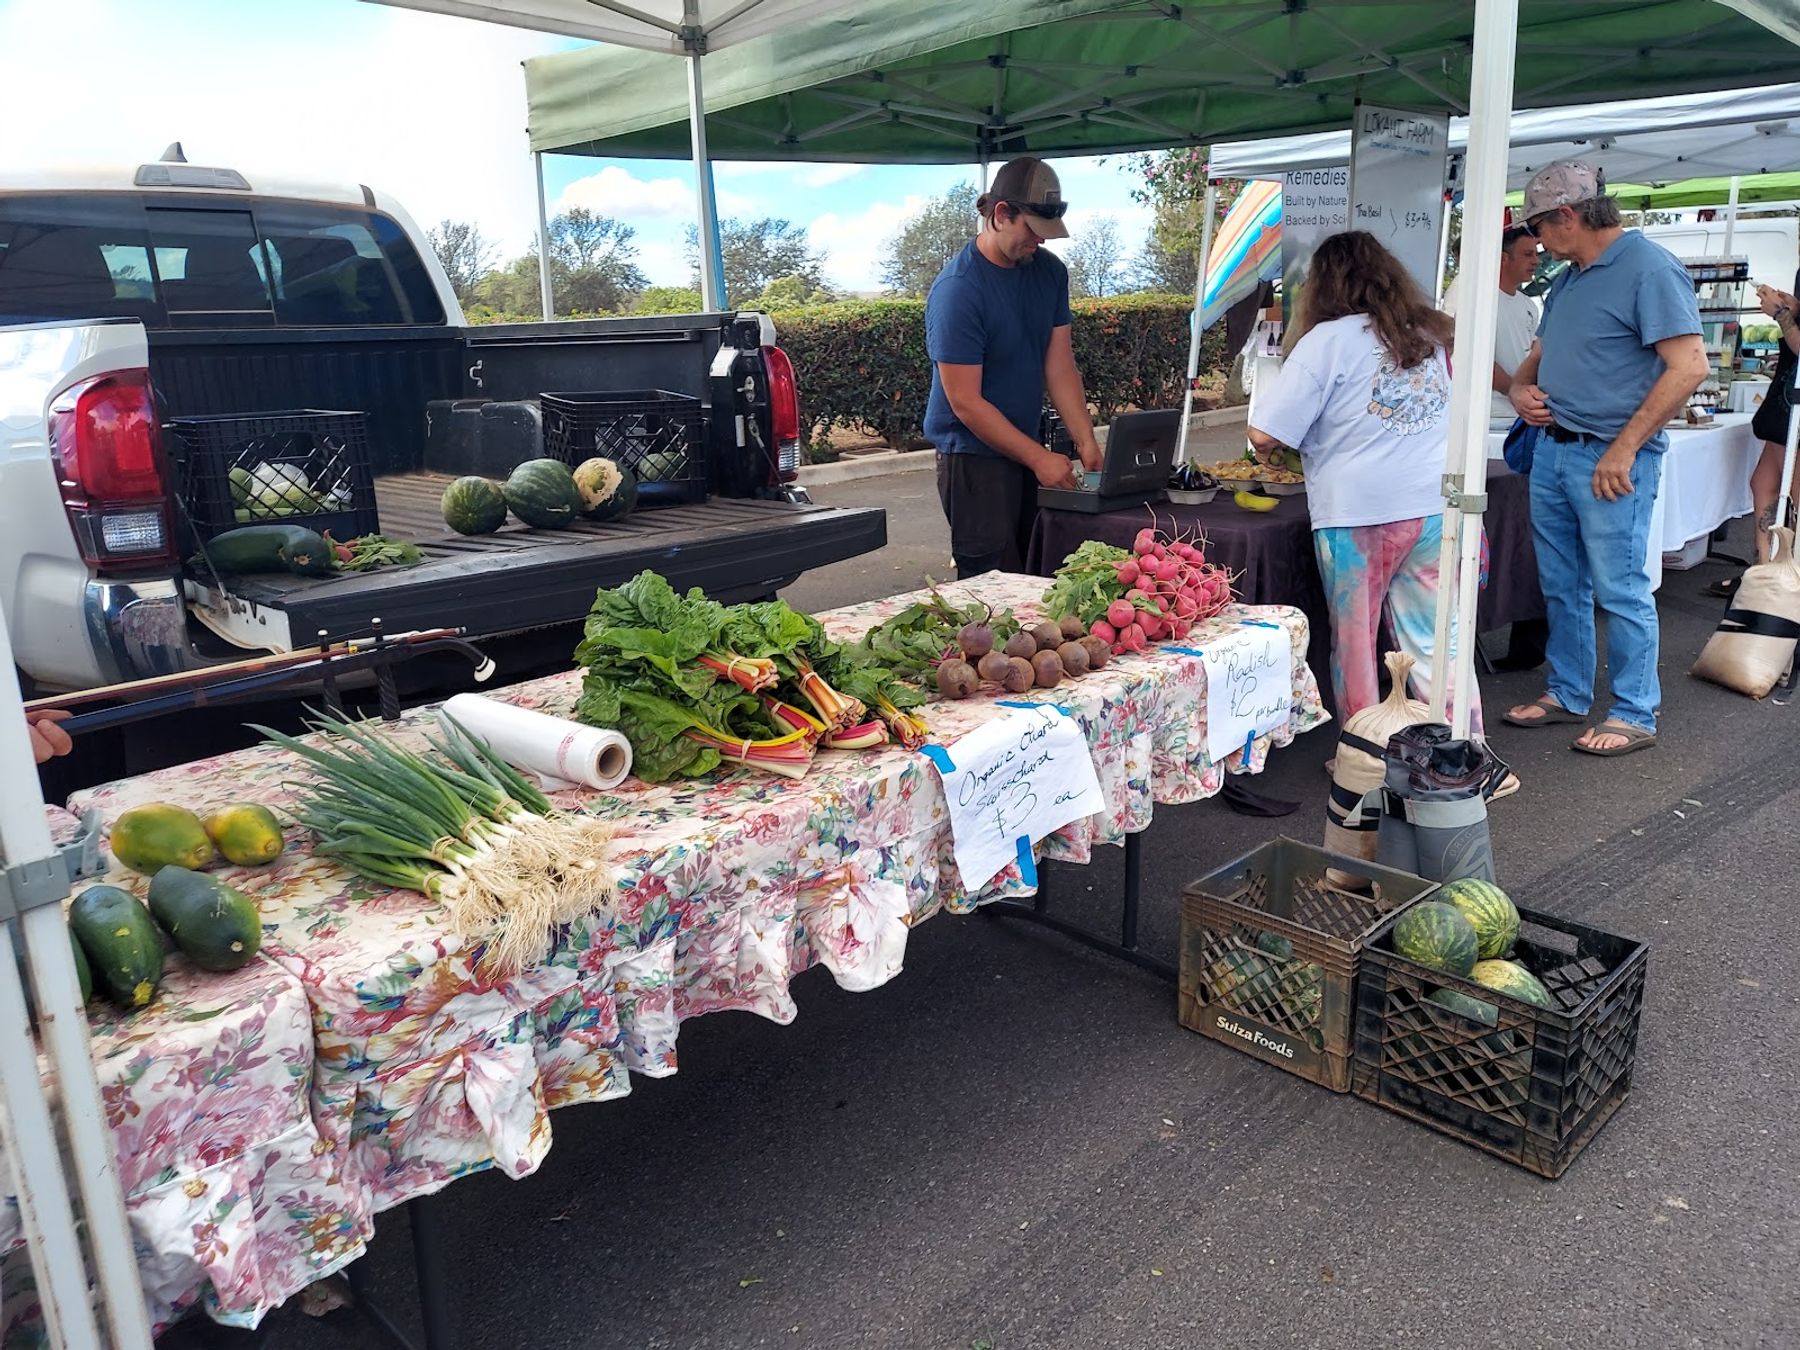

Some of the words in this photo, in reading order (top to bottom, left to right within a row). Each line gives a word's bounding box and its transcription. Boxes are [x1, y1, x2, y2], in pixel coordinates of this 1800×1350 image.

[1407, 120, 1434, 145] FARM
[1286, 168, 1347, 185] Remedies
[1286, 196, 1305, 206] Built
[1306, 196, 1316, 208] by
[1319, 196, 1347, 206] Nature
[1286, 215, 1317, 226] Backed
[1320, 215, 1330, 227] by
[1332, 214, 1346, 225] Sci
[1226, 640, 1279, 688] Radish
[959, 750, 1016, 807] Organic
[1052, 788, 1087, 806] ea
[1216, 1016, 1253, 1041] Suiza
[1253, 1031, 1294, 1059] Foods
